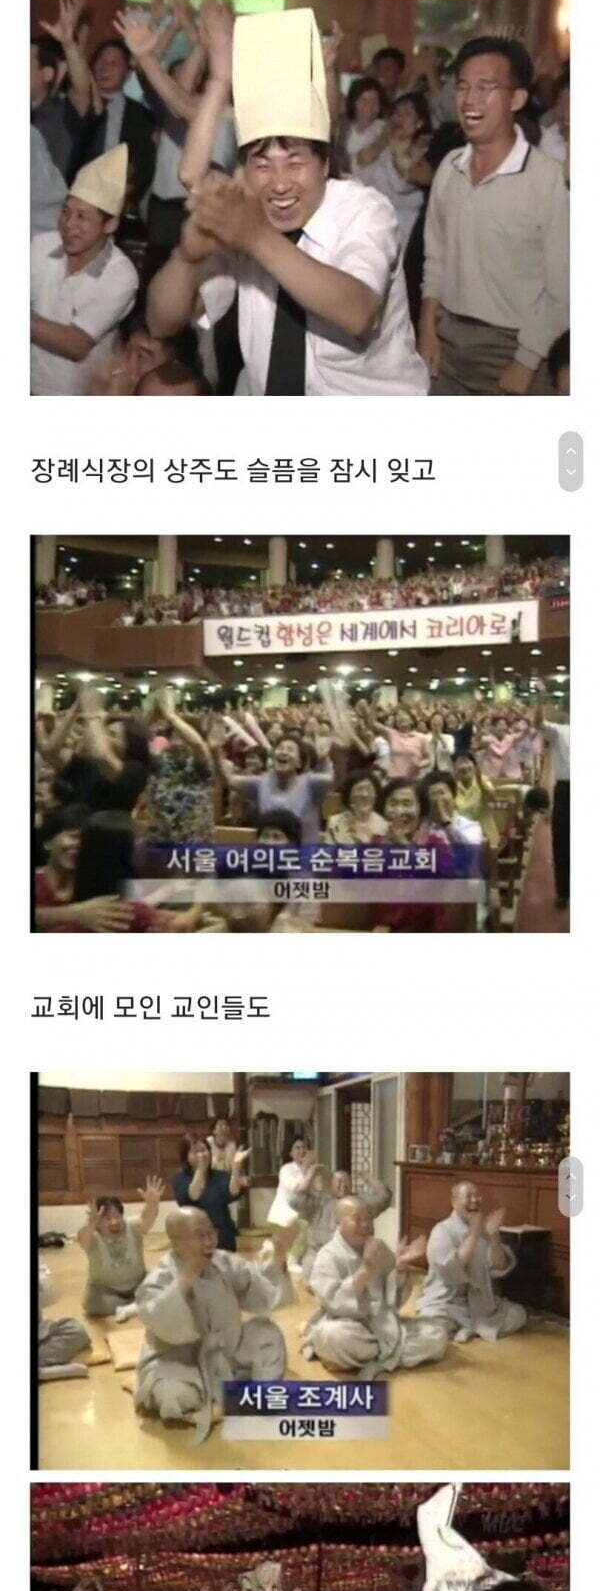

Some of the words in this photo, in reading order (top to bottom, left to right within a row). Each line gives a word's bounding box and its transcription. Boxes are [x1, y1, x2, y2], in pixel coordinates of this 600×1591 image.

[217, 623, 271, 650] 월드컵
[276, 620, 332, 648] 함성은
[340, 618, 417, 642] 세계에서
